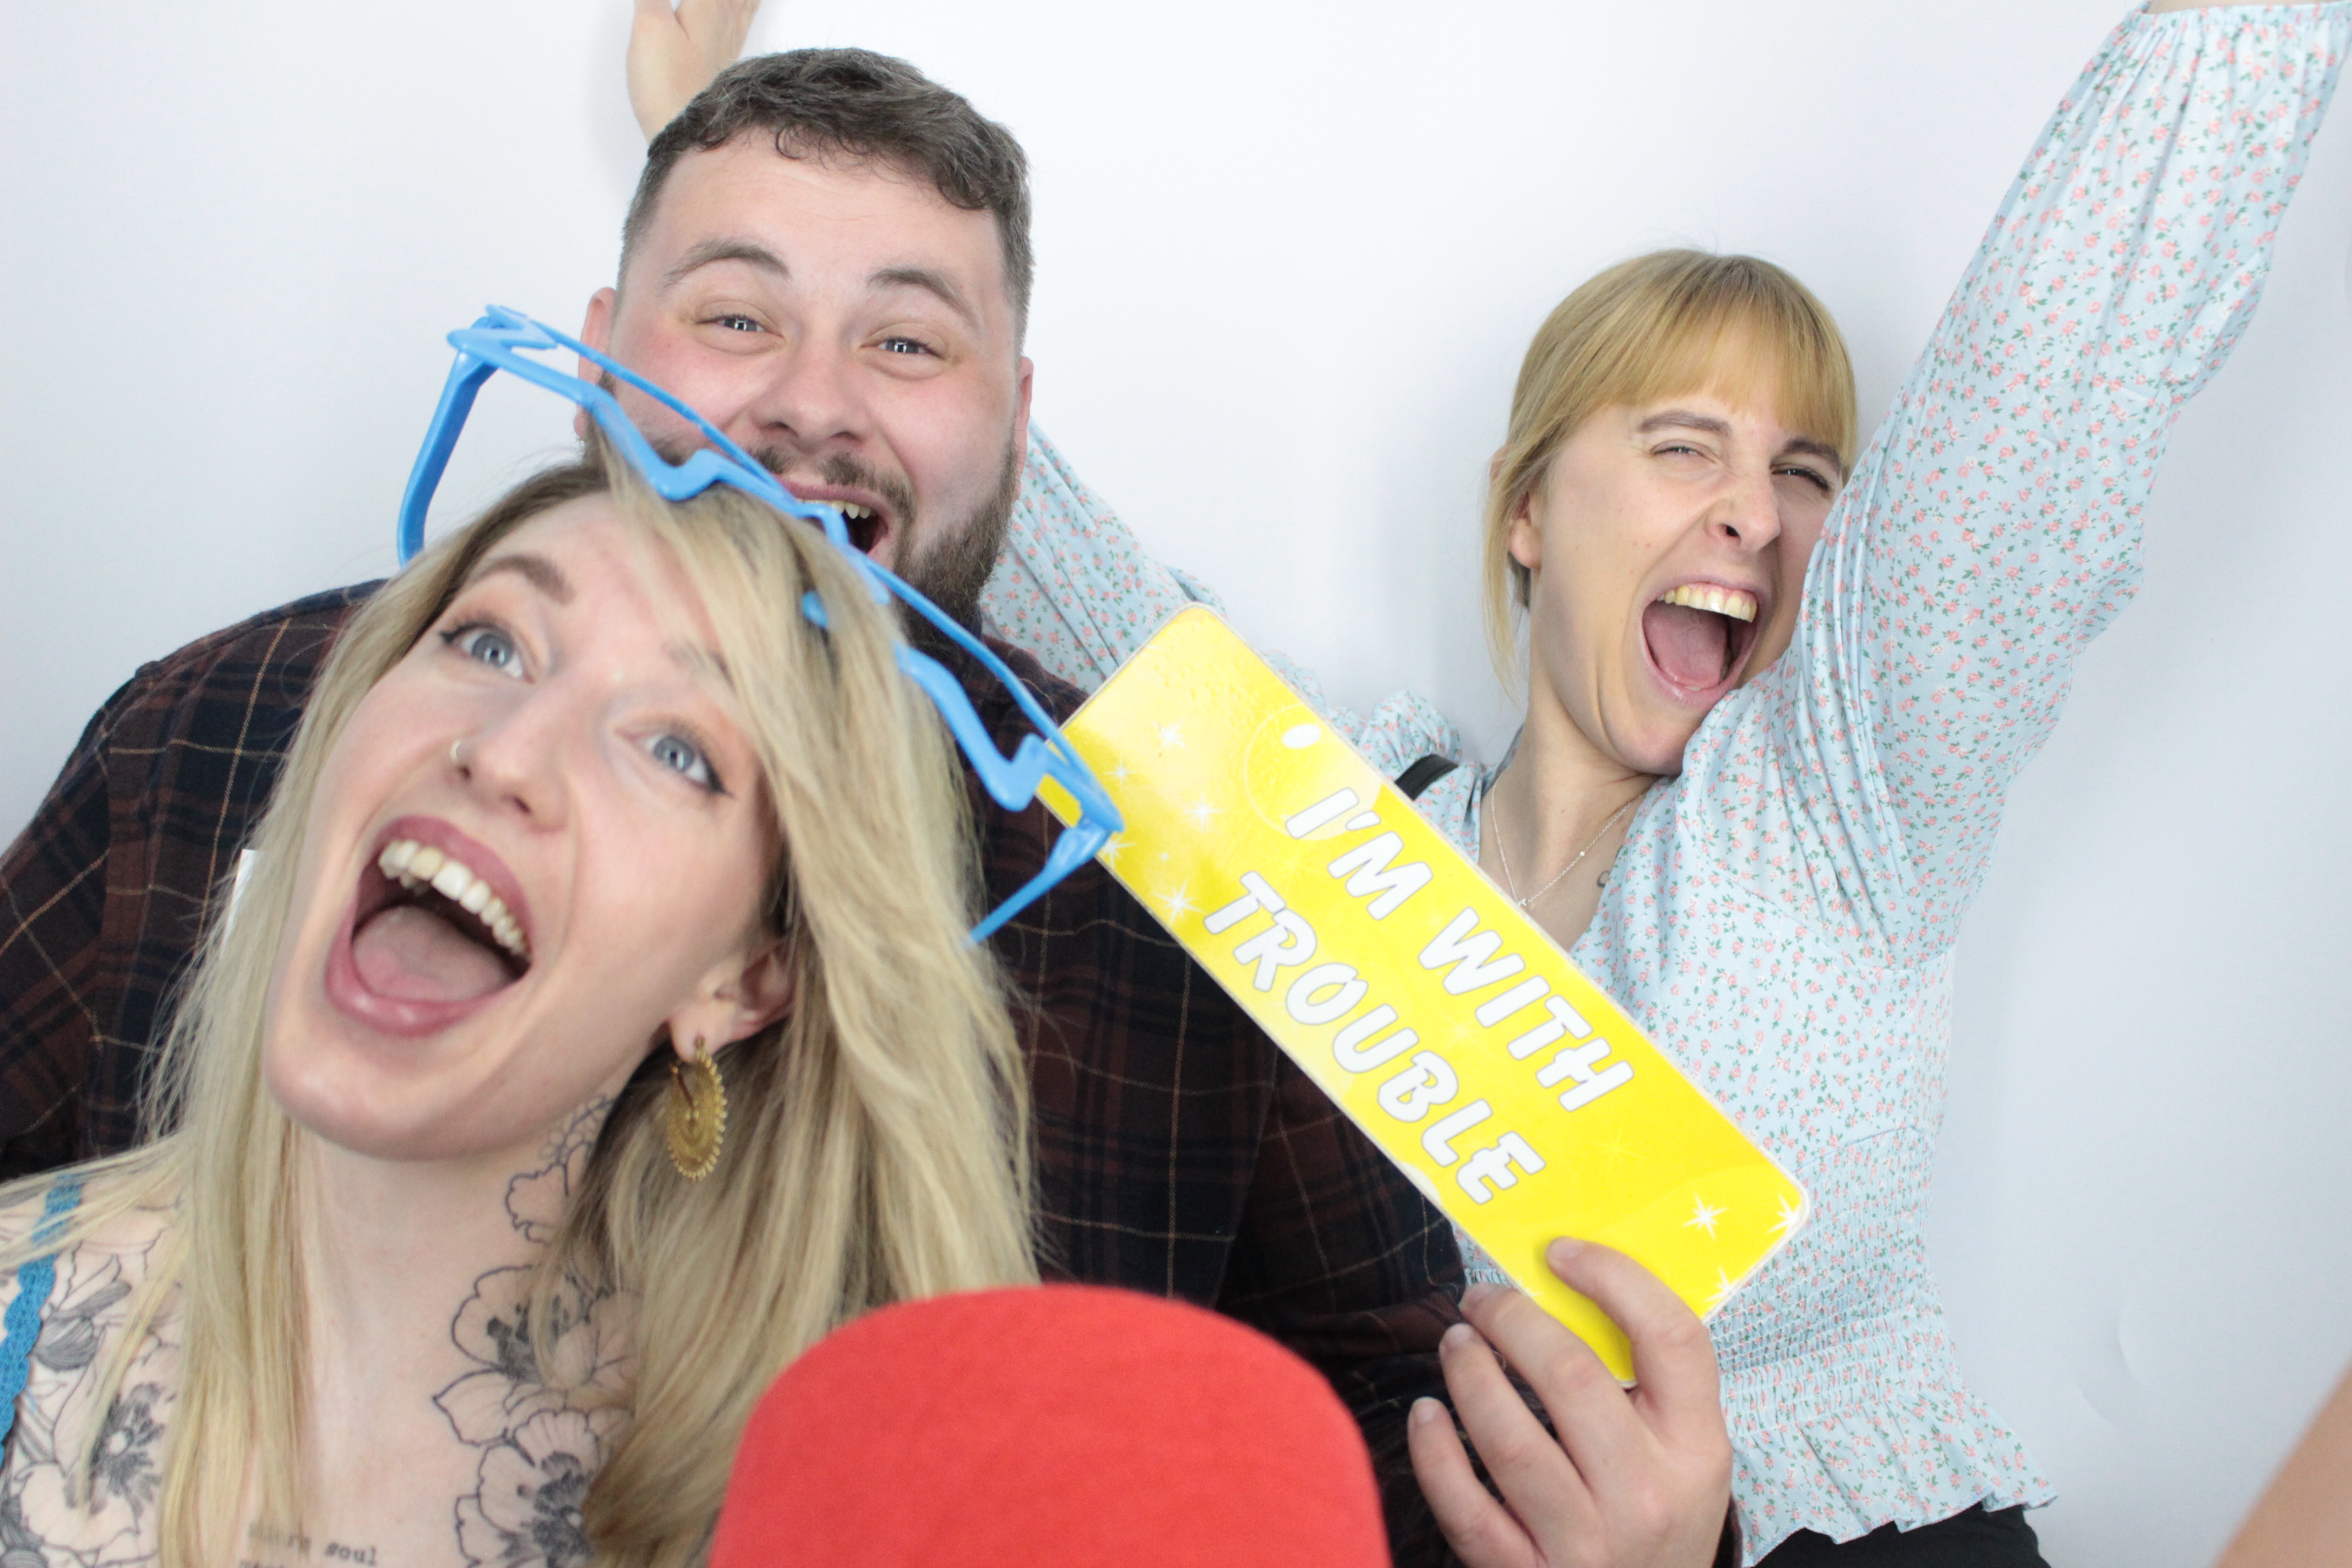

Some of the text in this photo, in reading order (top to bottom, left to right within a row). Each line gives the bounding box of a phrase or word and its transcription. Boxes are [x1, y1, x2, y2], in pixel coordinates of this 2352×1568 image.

[1204, 870, 1547, 1205] TROUBLE
[1286, 787, 1634, 1112] I'M WITH
